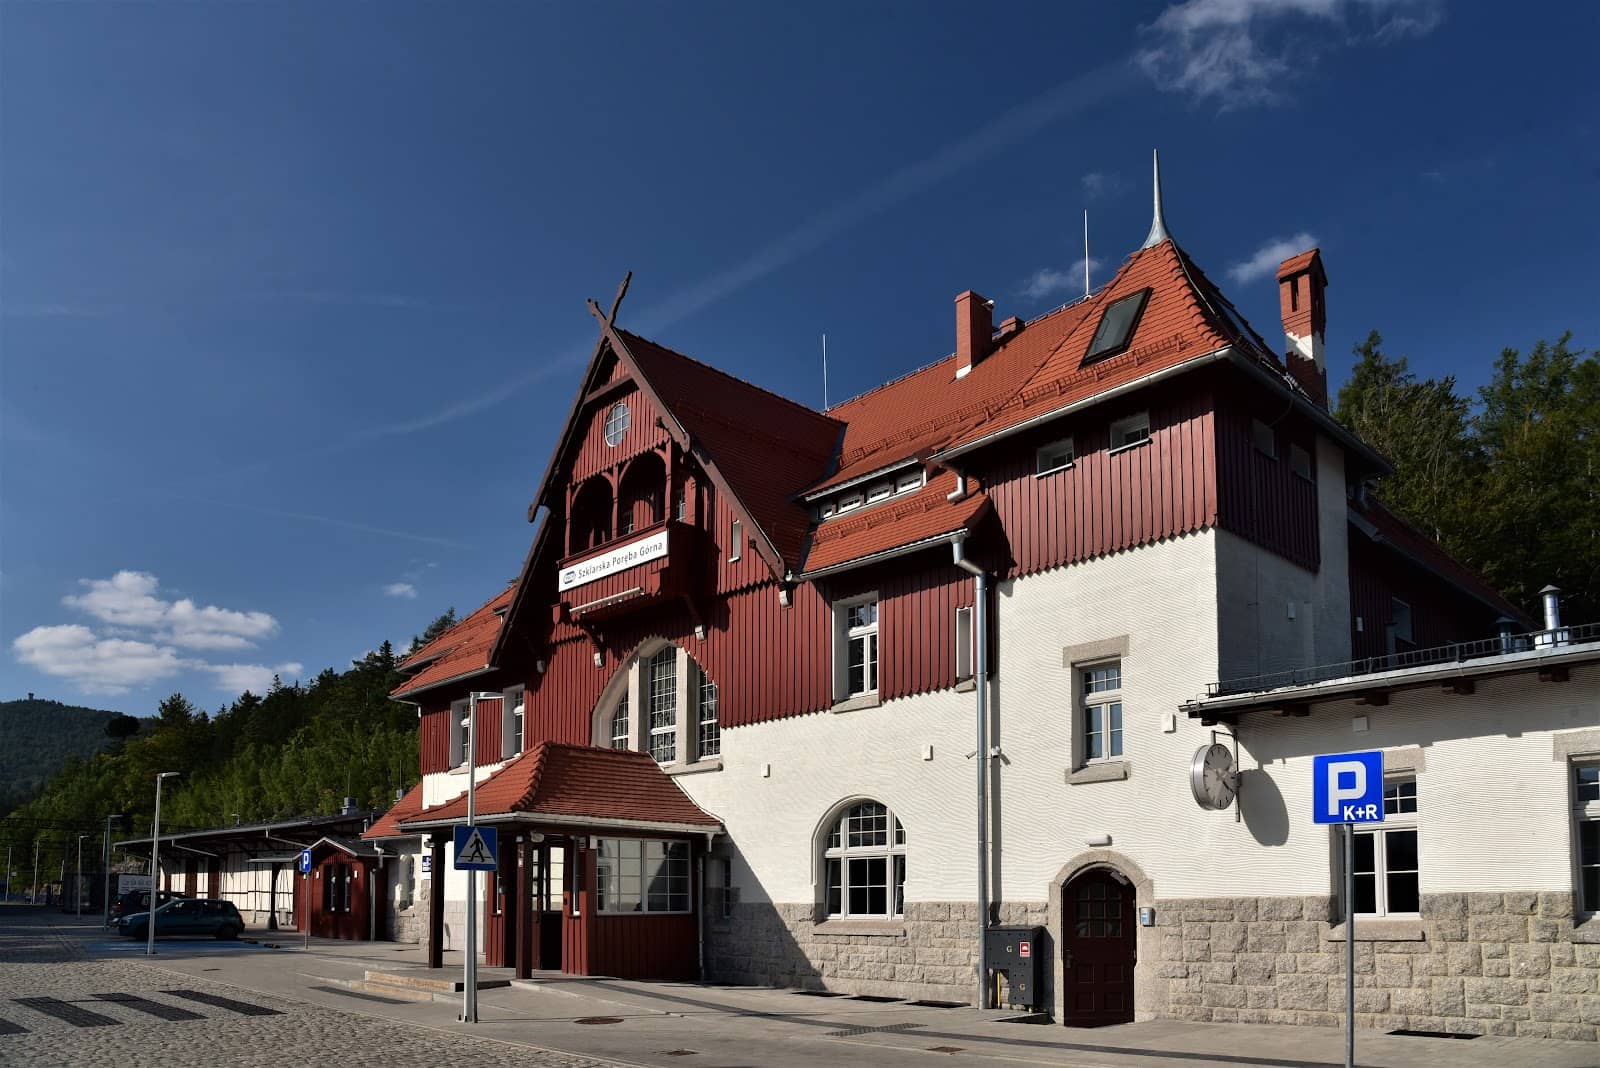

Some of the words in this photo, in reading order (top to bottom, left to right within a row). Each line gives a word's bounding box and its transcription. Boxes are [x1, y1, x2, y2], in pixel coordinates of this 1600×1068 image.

[578, 560, 611, 579] Szklarska
[612, 551, 638, 567] Poręba
[640, 542, 663, 557] Górna
[1328, 761, 1367, 815] P
[1343, 804, 1379, 821] K+R
[303, 852, 309, 869] P
